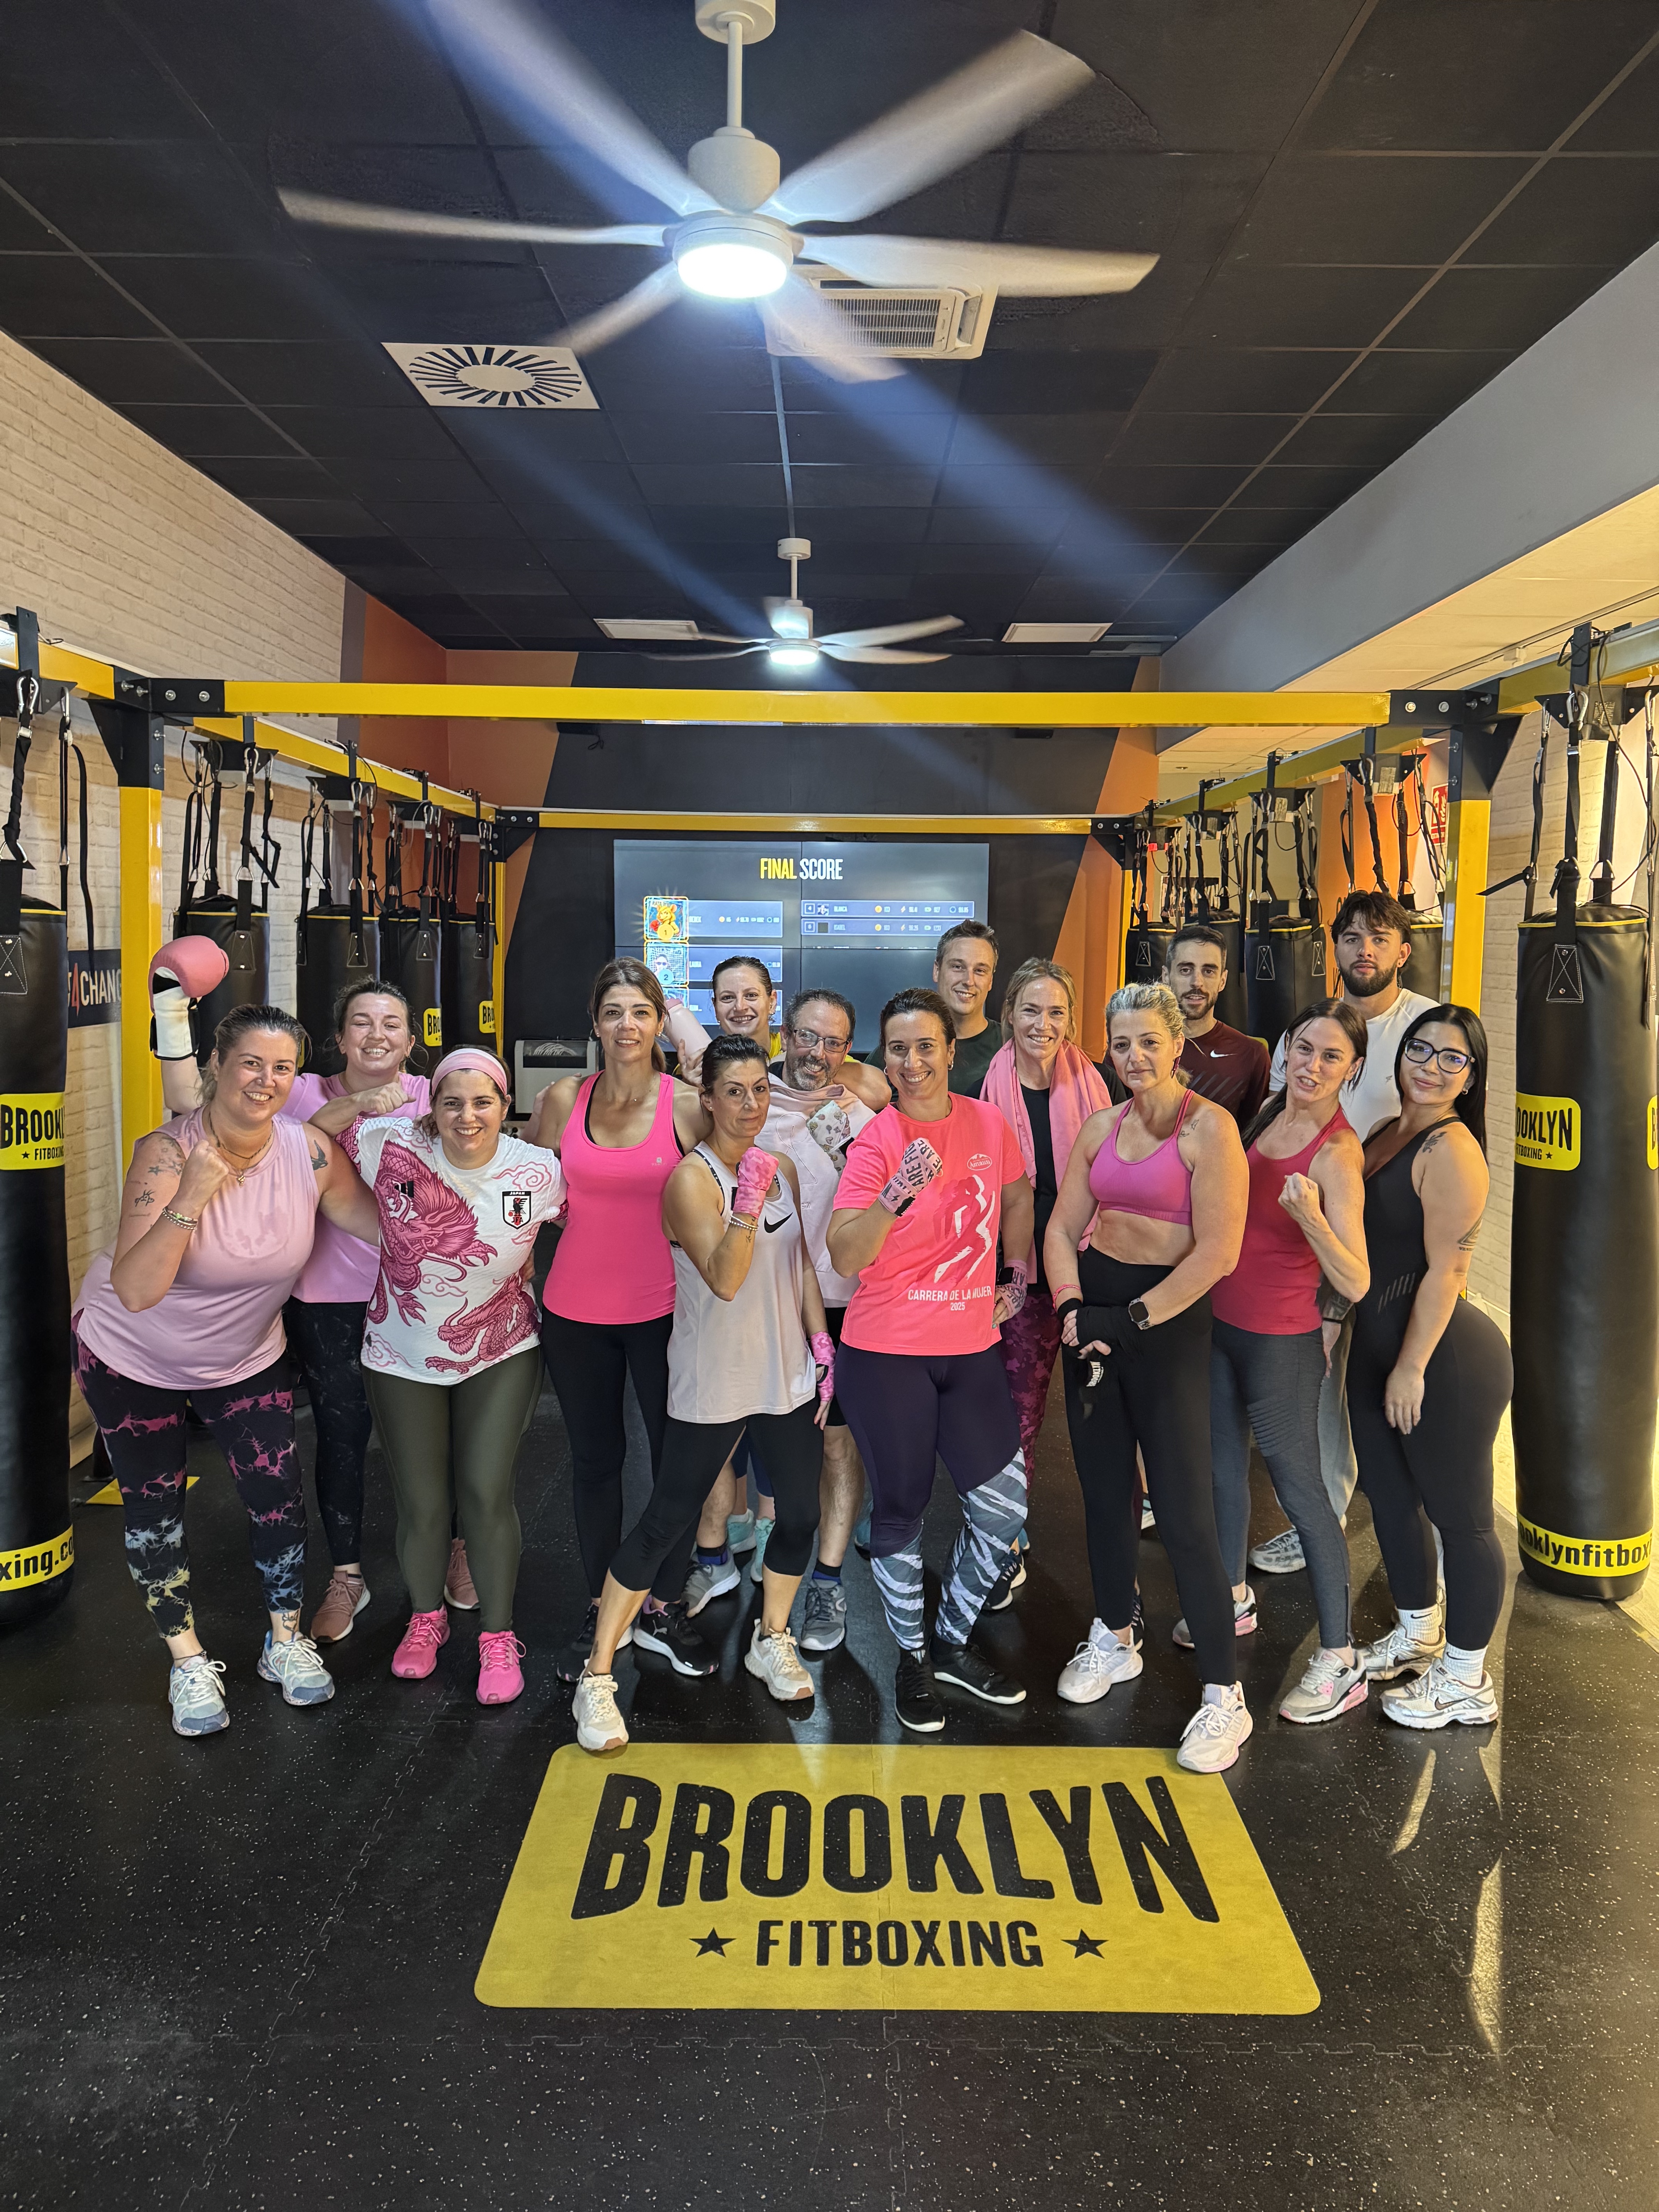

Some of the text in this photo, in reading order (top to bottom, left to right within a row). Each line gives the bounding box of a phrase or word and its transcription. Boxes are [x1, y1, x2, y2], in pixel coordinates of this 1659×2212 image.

[760, 858, 843, 880] FINAL SCORE
[1516, 1107, 1572, 1151] OOKLYN
[907, 1162, 924, 1187] ARE
[908, 1289, 948, 1302] CARRERA
[950, 1290, 959, 1301] DE
[962, 1289, 971, 1300] LA
[972, 1285, 993, 1299] MUJER
[950, 1302, 965, 1311] 2025
[571, 1772, 1221, 1923] BROOKLYN
[756, 1920, 1044, 1968] FITBOXING
